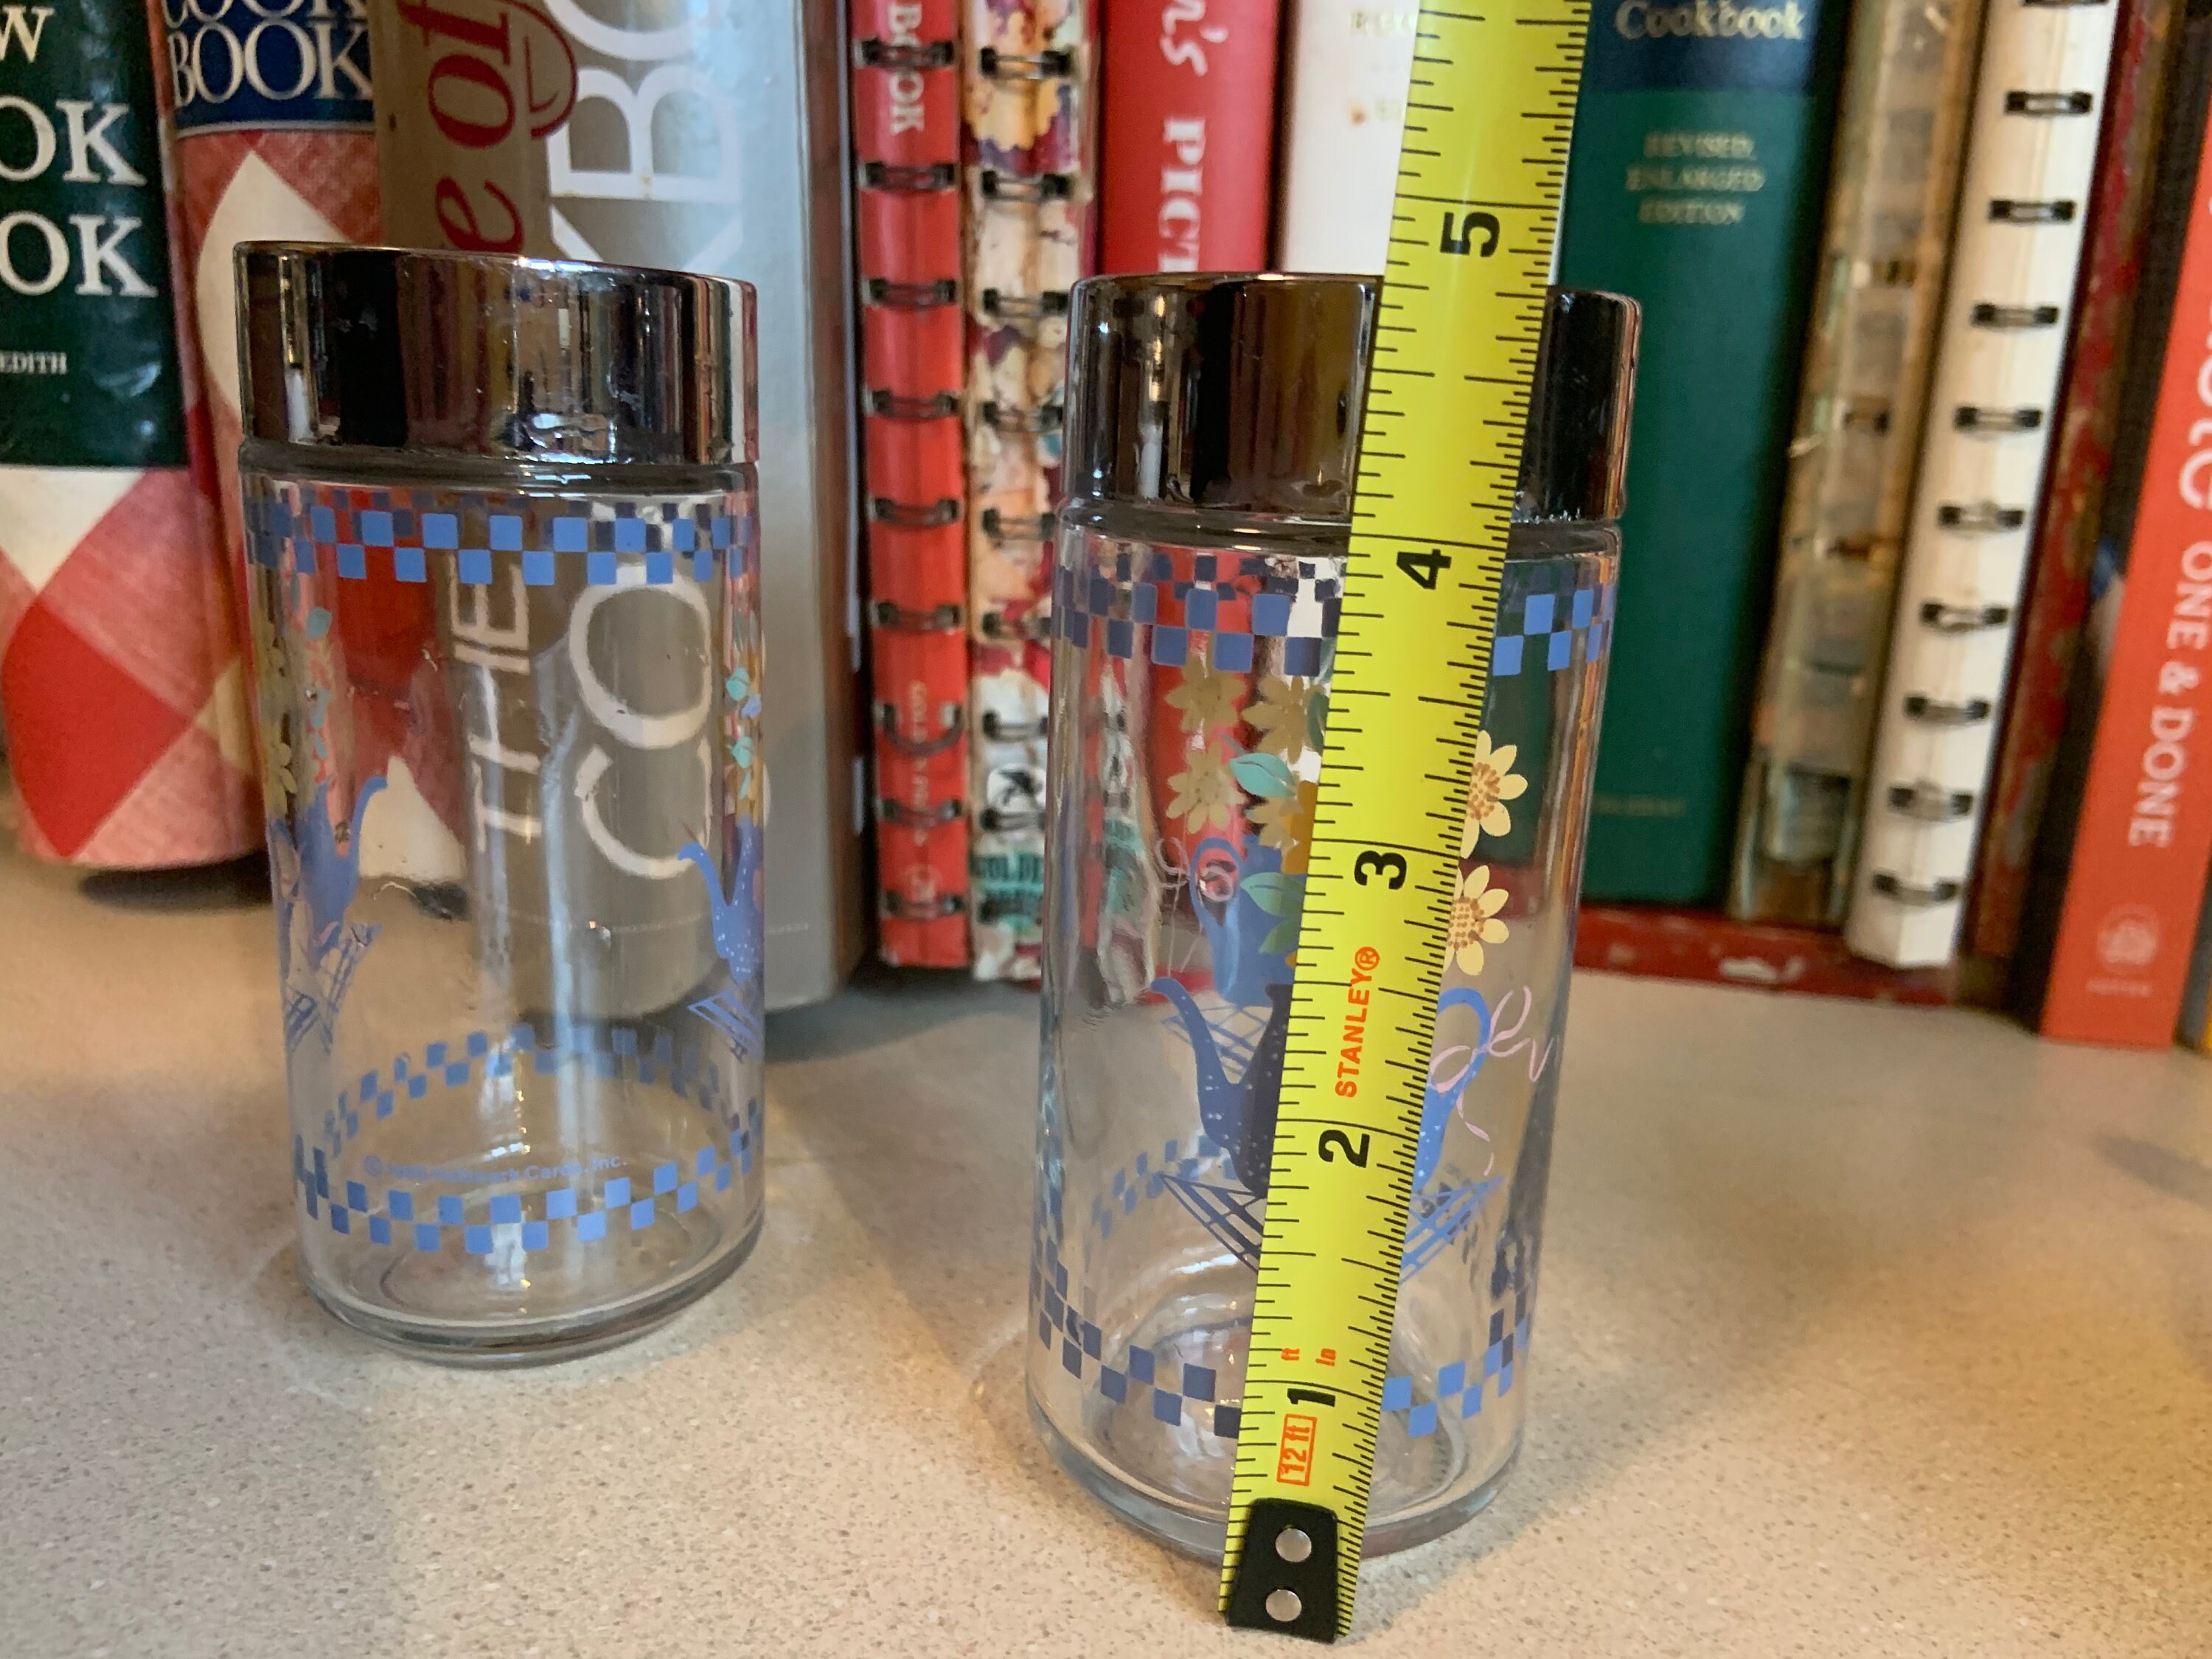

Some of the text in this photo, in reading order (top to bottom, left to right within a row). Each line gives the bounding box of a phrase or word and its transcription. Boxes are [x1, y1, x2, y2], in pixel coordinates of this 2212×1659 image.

[1613, 0, 1806, 39] Cookbook
[166, 18, 374, 108] BOOK
[0, 211, 157, 297] OK
[1439, 212, 1500, 258] 5
[1397, 549, 1453, 590] 4
[2166, 540, 2212, 650] ONE
[2159, 661, 2201, 695] &
[449, 552, 541, 854] THE
[2128, 706, 2194, 849] DONE
[1354, 849, 1408, 891] 3
[1318, 1129, 1370, 1168] 2
[1287, 1388, 1335, 1407] 1
[1280, 1447, 1307, 1474] 12
